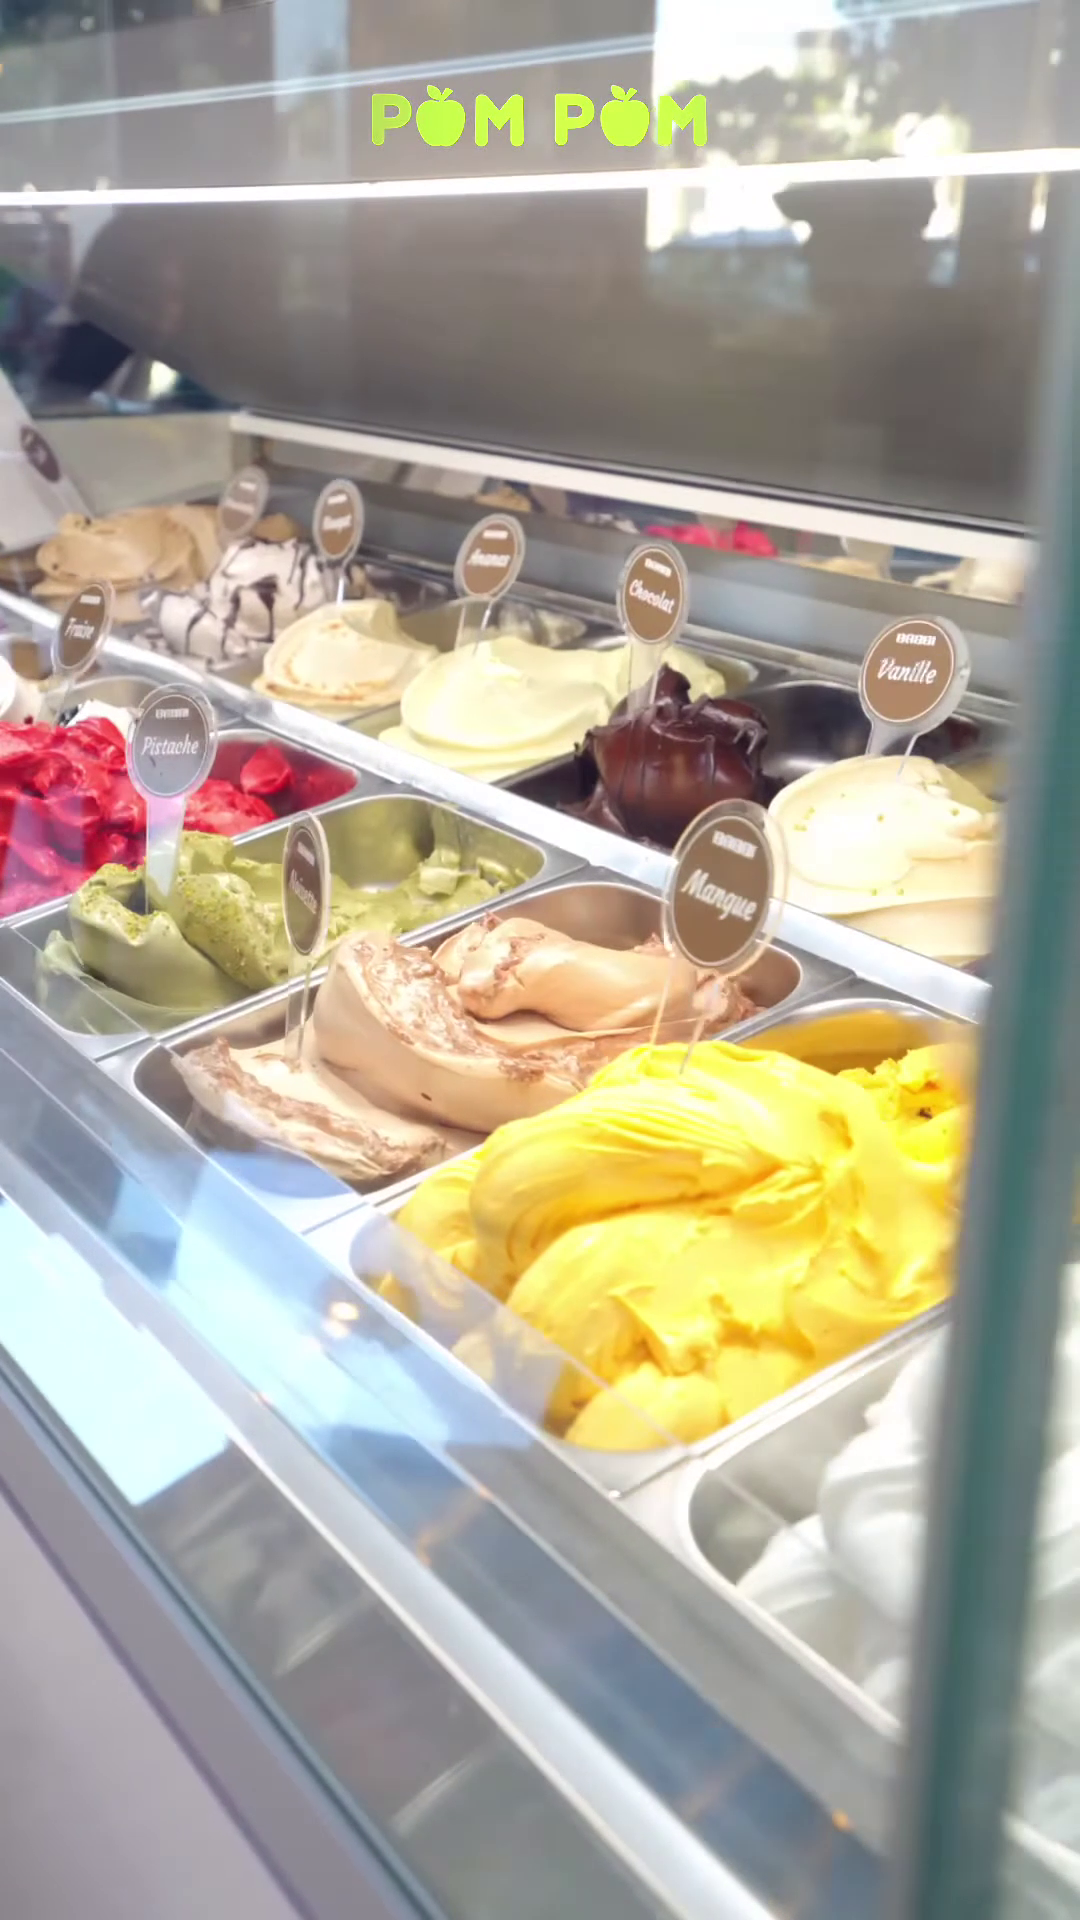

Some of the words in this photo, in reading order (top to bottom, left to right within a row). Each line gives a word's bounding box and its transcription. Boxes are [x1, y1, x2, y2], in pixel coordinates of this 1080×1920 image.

[629, 579, 674, 614] Chocolat
[877, 657, 937, 685] Vanille
[141, 733, 199, 756] Pistache
[679, 868, 757, 922] Mangue
